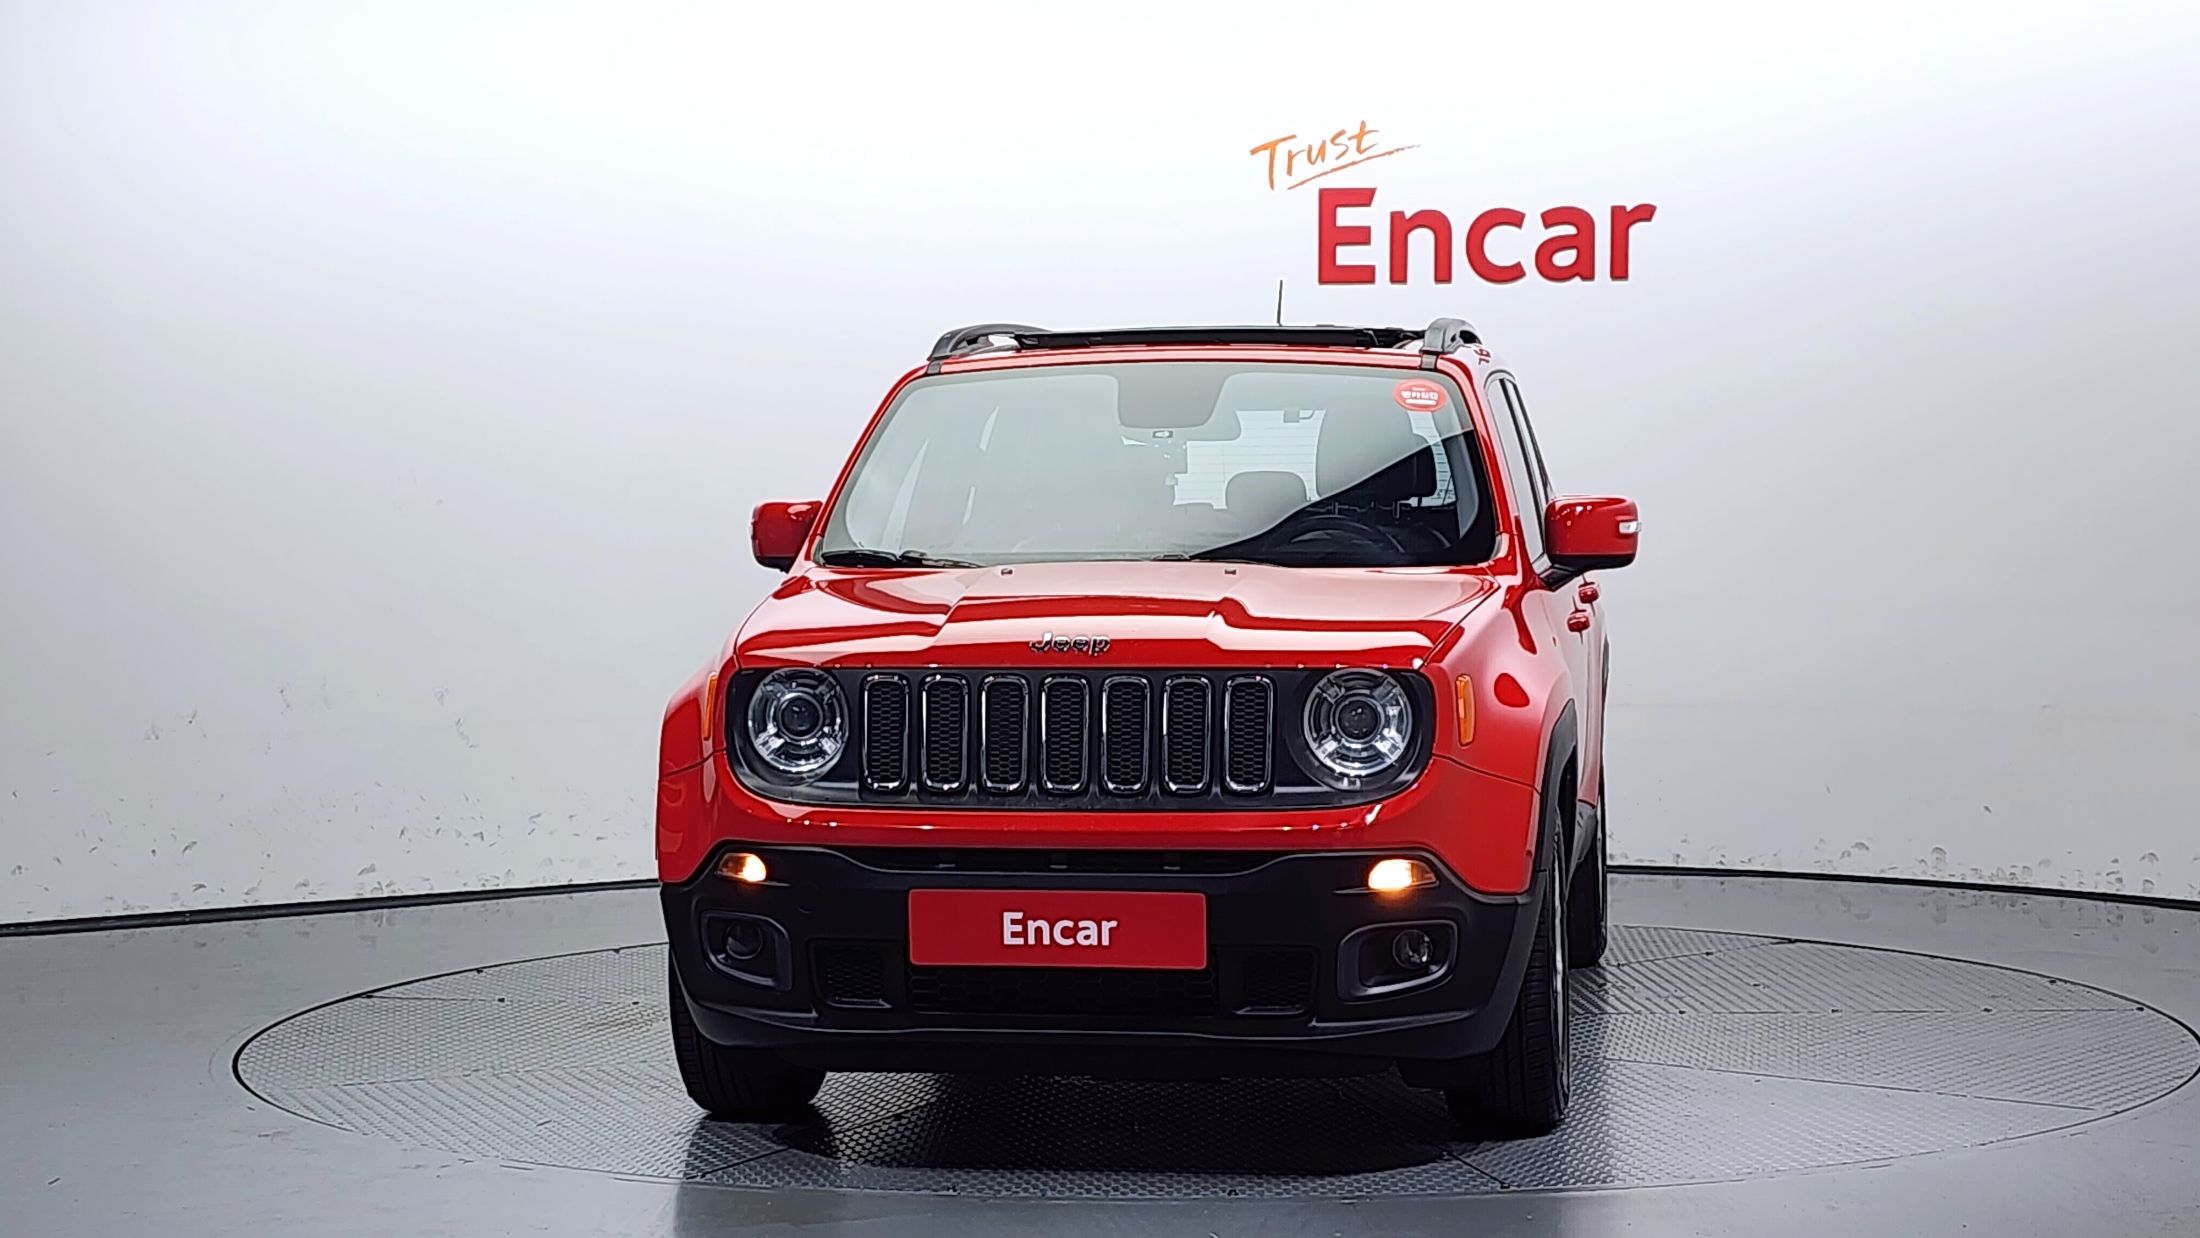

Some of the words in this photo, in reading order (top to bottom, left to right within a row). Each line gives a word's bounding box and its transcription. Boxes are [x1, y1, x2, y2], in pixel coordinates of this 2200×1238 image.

[1249, 119, 1380, 191] Trust
[1318, 187, 1657, 286] Encar
[1029, 631, 1112, 657] Jeep
[1002, 911, 1118, 947] Encar
